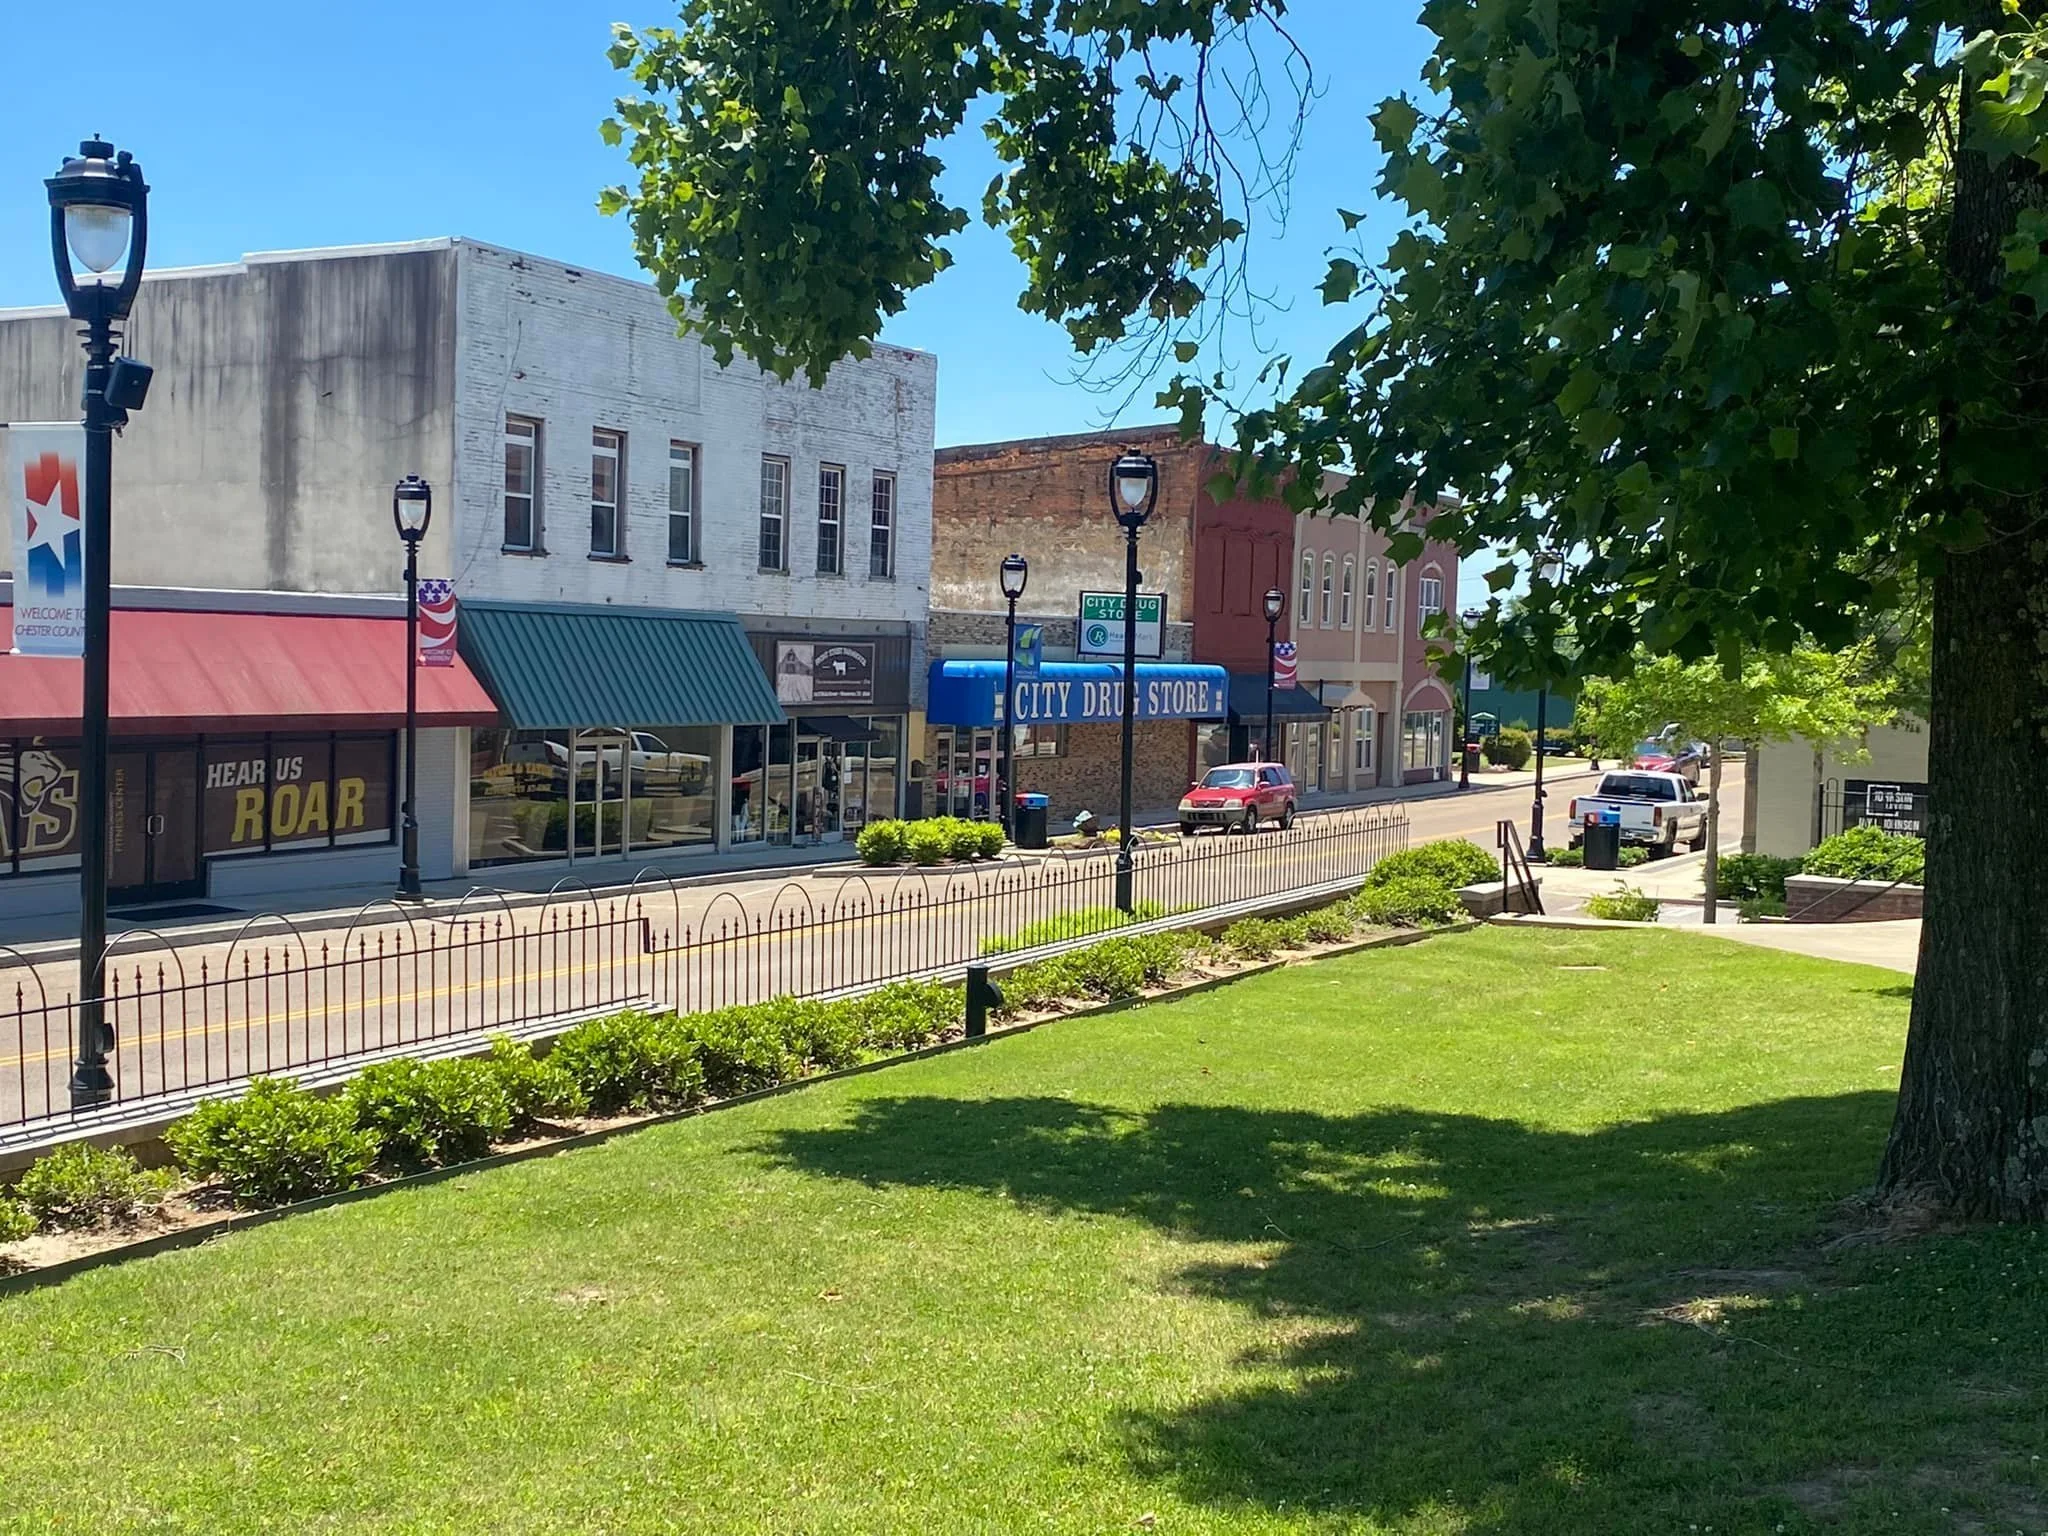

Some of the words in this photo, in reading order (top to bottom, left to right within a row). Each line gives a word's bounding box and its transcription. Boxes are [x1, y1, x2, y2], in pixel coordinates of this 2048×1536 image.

[1086, 597, 1116, 608] CITY
[1120, 599, 1157, 610] DUG
[20, 607, 72, 620] WELCOME
[1099, 609, 1143, 620] STOE
[15, 624, 51, 636] CHESTER
[52, 625, 86, 637] COUNT
[1014, 681, 1071, 720] CITY
[1148, 680, 1209, 715] STORE
[206, 759, 266, 789] HEAR
[276, 756, 303, 781] US
[231, 777, 365, 843] ROAR
